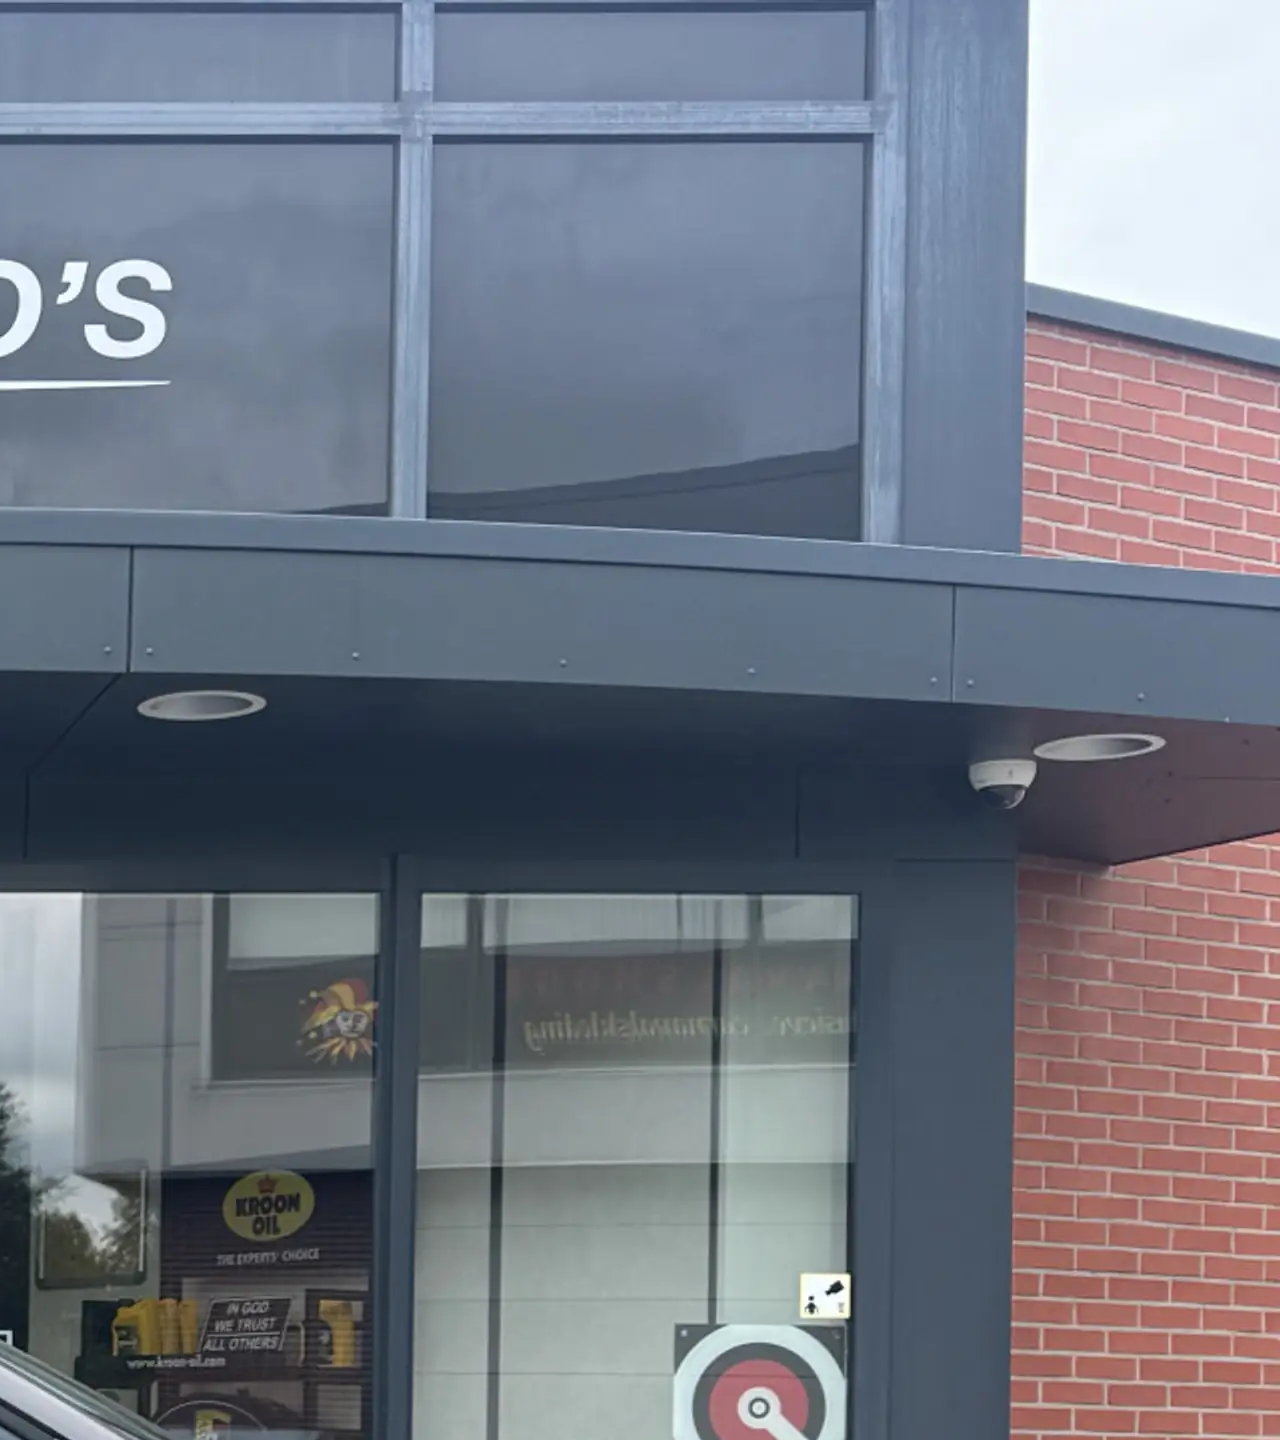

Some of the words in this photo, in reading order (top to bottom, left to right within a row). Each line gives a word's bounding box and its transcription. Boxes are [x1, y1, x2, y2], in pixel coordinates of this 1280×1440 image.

[235, 1192, 301, 1218] KROON
[252, 1214, 282, 1236] OIL
[281, 1248, 320, 1262] CHOICE
[226, 1302, 239, 1316] IN
[242, 1301, 269, 1316] GOD
[214, 1318, 236, 1333] WE
[238, 1316, 278, 1332] TRUST
[203, 1338, 226, 1352] ALL
[228, 1336, 278, 1351] OTHERS
